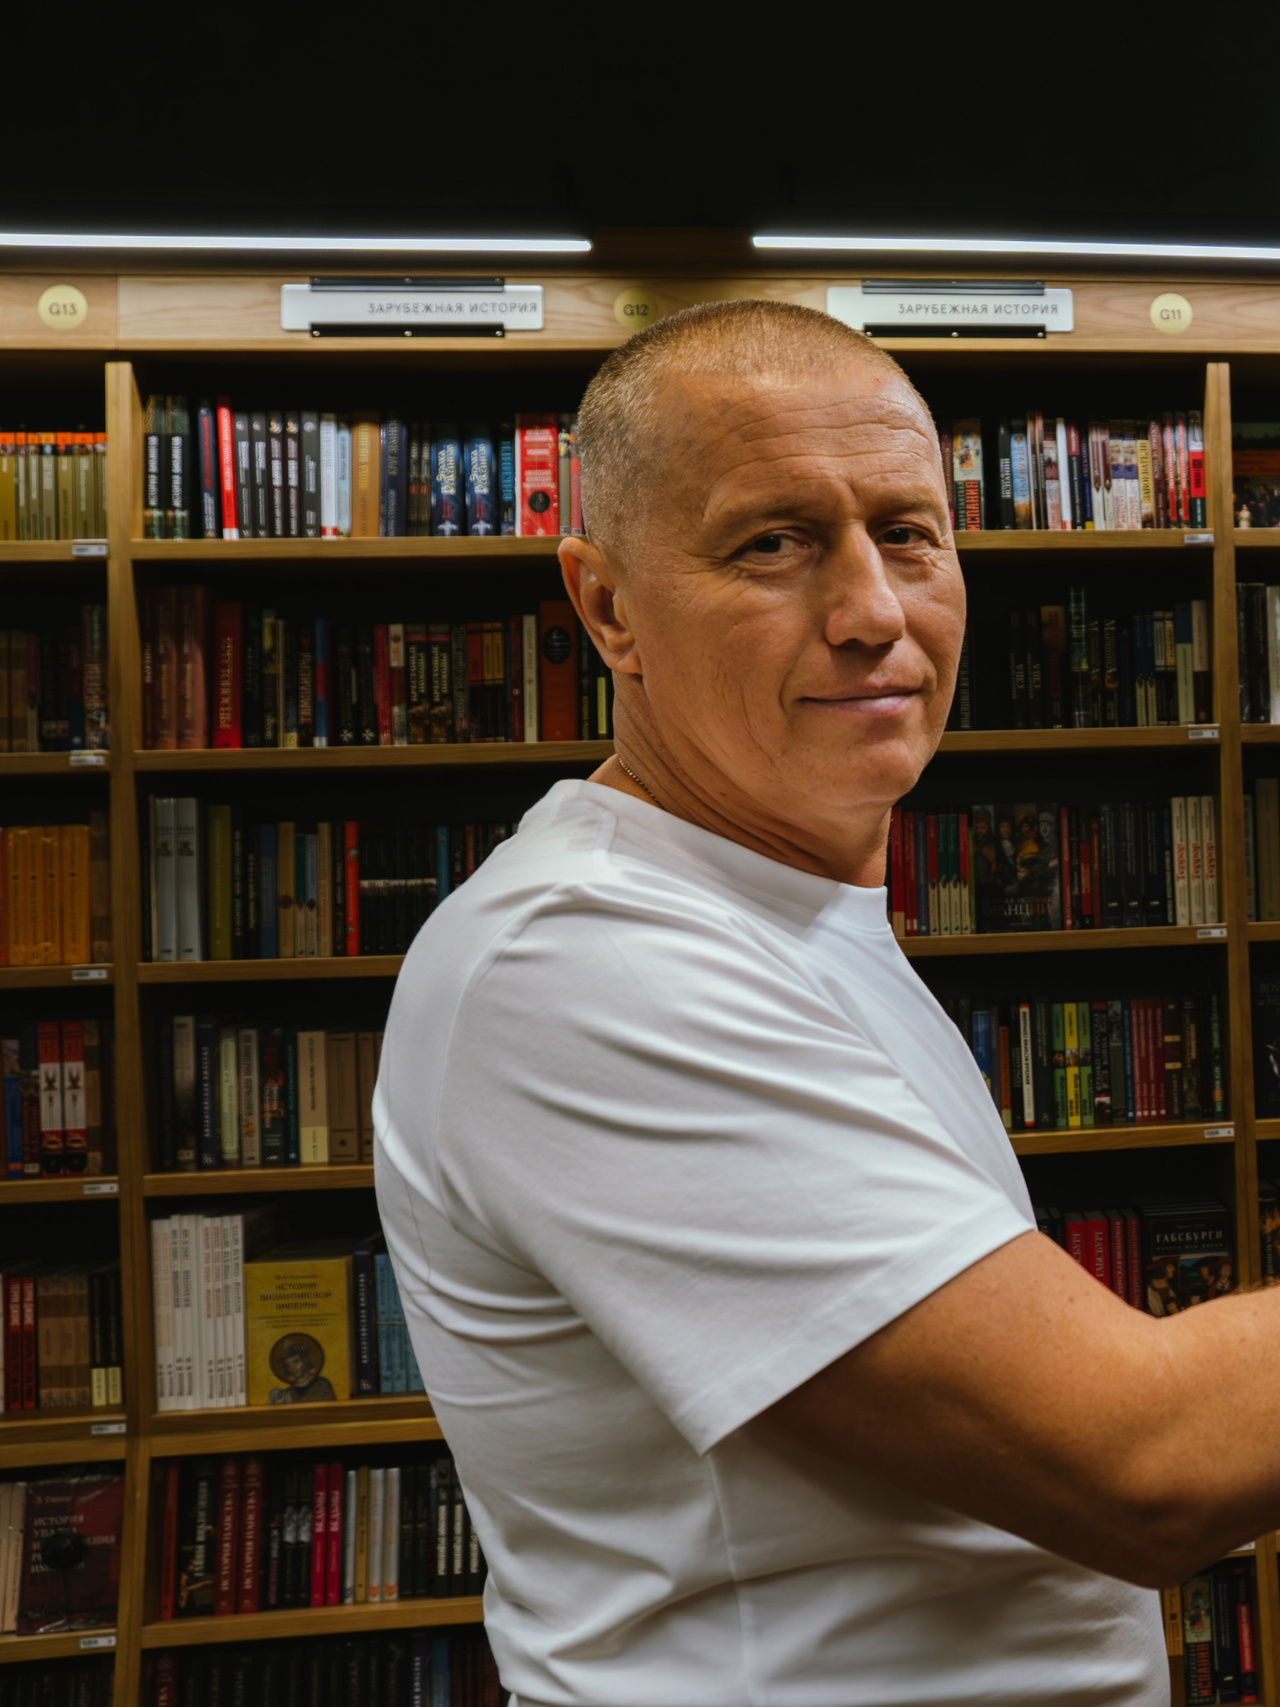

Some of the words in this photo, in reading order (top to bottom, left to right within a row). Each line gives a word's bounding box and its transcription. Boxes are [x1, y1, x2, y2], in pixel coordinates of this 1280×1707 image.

[48, 302, 78, 318] G13
[367, 302, 463, 315] ЗАРУБЕЖНАЯ
[469, 302, 537, 314] ИСТОРИЯ
[623, 304, 648, 316] G12
[897, 302, 989, 316] ЗАРУБЕЖНАЯ
[993, 303, 1058, 315] ИСТОРИЯ
[1160, 308, 1182, 321] G11
